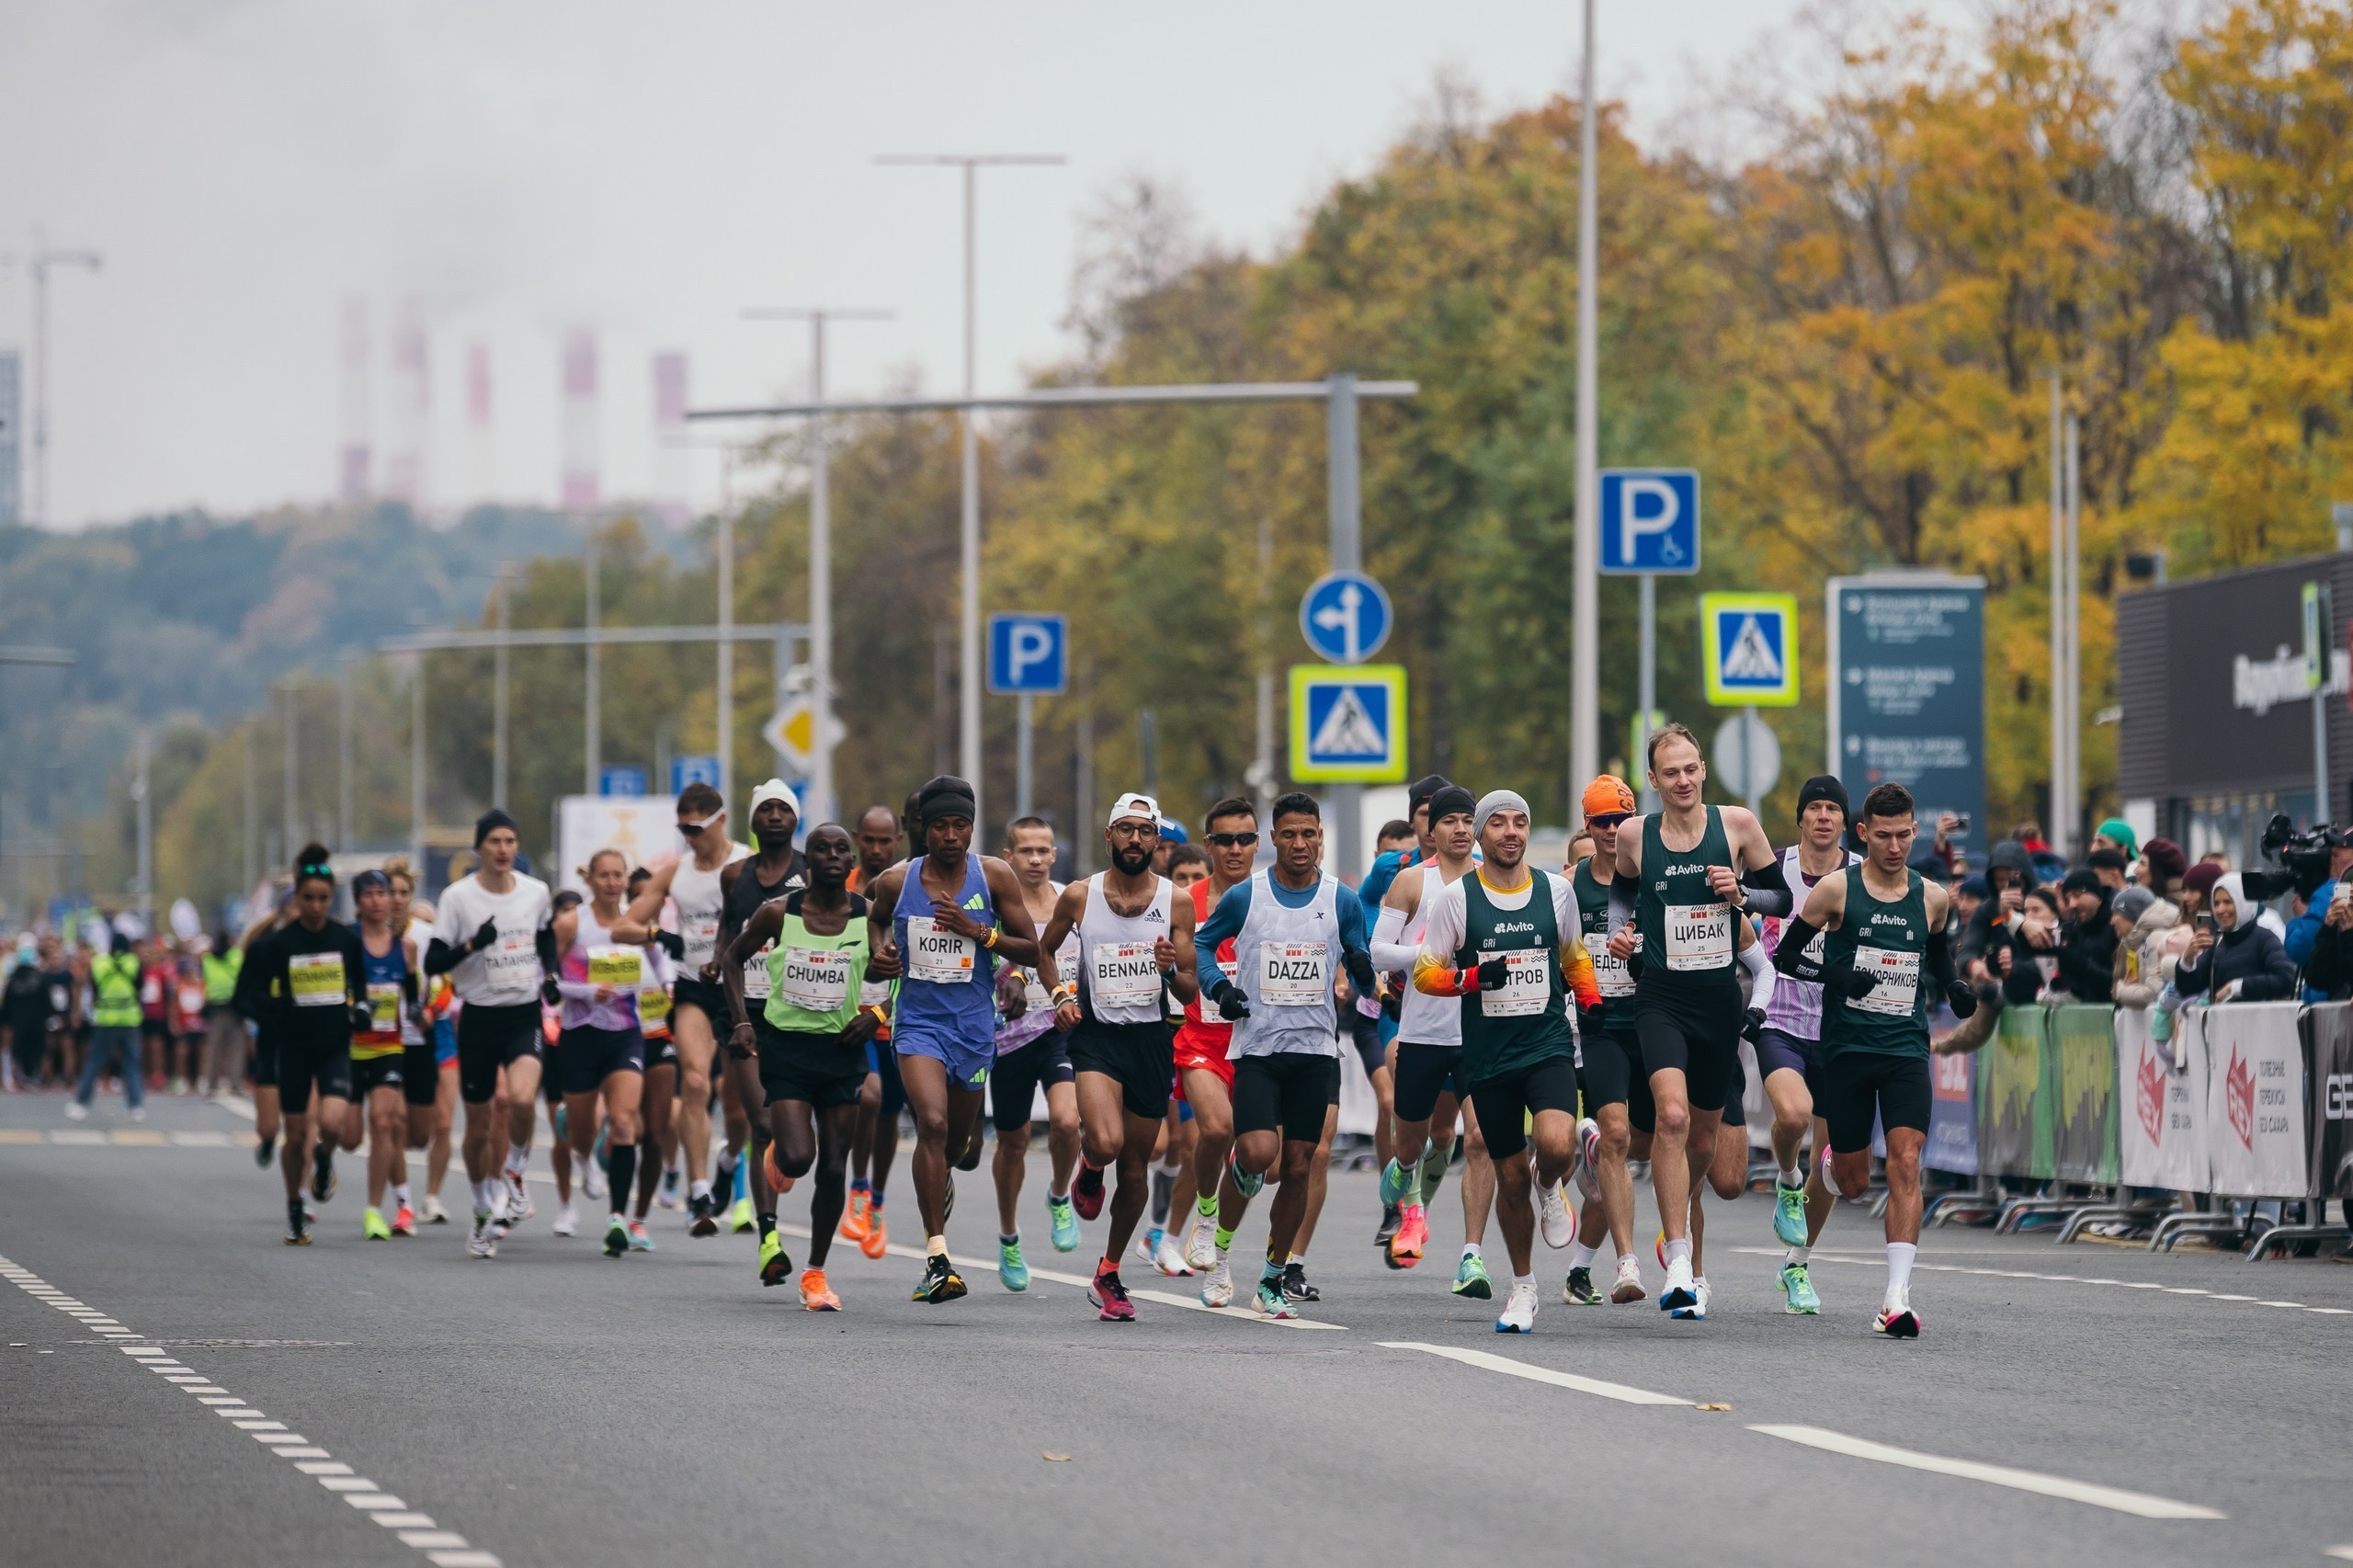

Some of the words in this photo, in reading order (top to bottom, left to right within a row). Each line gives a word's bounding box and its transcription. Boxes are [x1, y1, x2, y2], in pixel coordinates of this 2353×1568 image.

[1620, 479, 1680, 563] P
[1009, 625, 1052, 686] P
[1677, 864, 1705, 875] Avito
[1655, 881, 1667, 891] GRi
[1583, 913, 1593, 921] GRi
[1881, 915, 1907, 926] Avito
[1506, 922, 1534, 932] Avito
[1675, 923, 1724, 943] ЦИБАК
[1859, 927, 1871, 937] GRi
[919, 937, 962, 953] KORIR
[1483, 938, 1495, 948] GRi
[787, 965, 845, 984] CHUMBA
[1098, 961, 1157, 978] BENNAR
[1268, 960, 1319, 980] DAZZA
[1805, 967, 1819, 977] cep
[1508, 969, 1543, 985] ТРОВ
